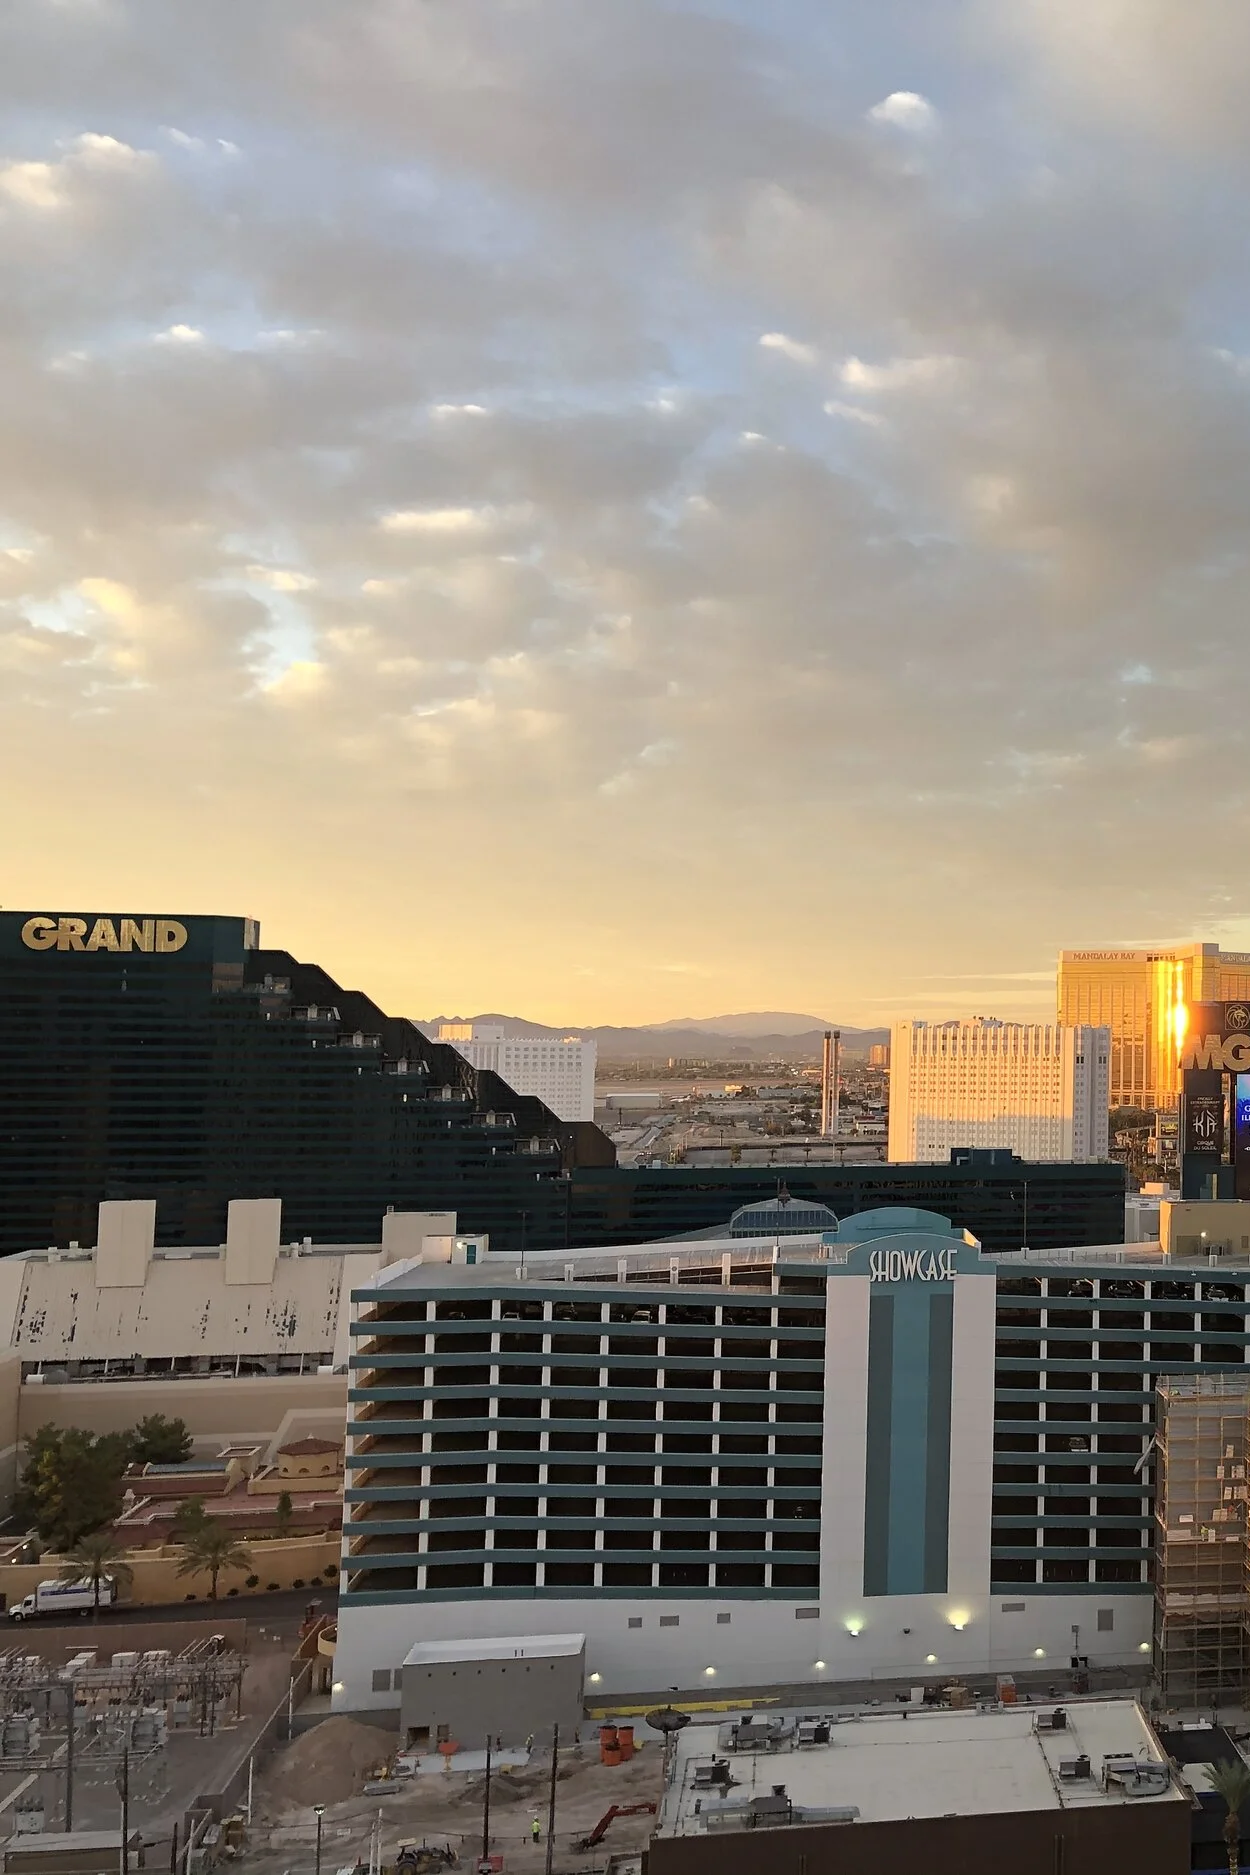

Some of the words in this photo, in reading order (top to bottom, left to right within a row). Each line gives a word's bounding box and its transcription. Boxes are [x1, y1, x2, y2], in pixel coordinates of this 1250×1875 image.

[22, 917, 188, 952] GRAND
[1073, 952, 1118, 960] MANDALAY
[1120, 952, 1136, 960] BAY
[869, 1249, 958, 1282] SHOWCASE
